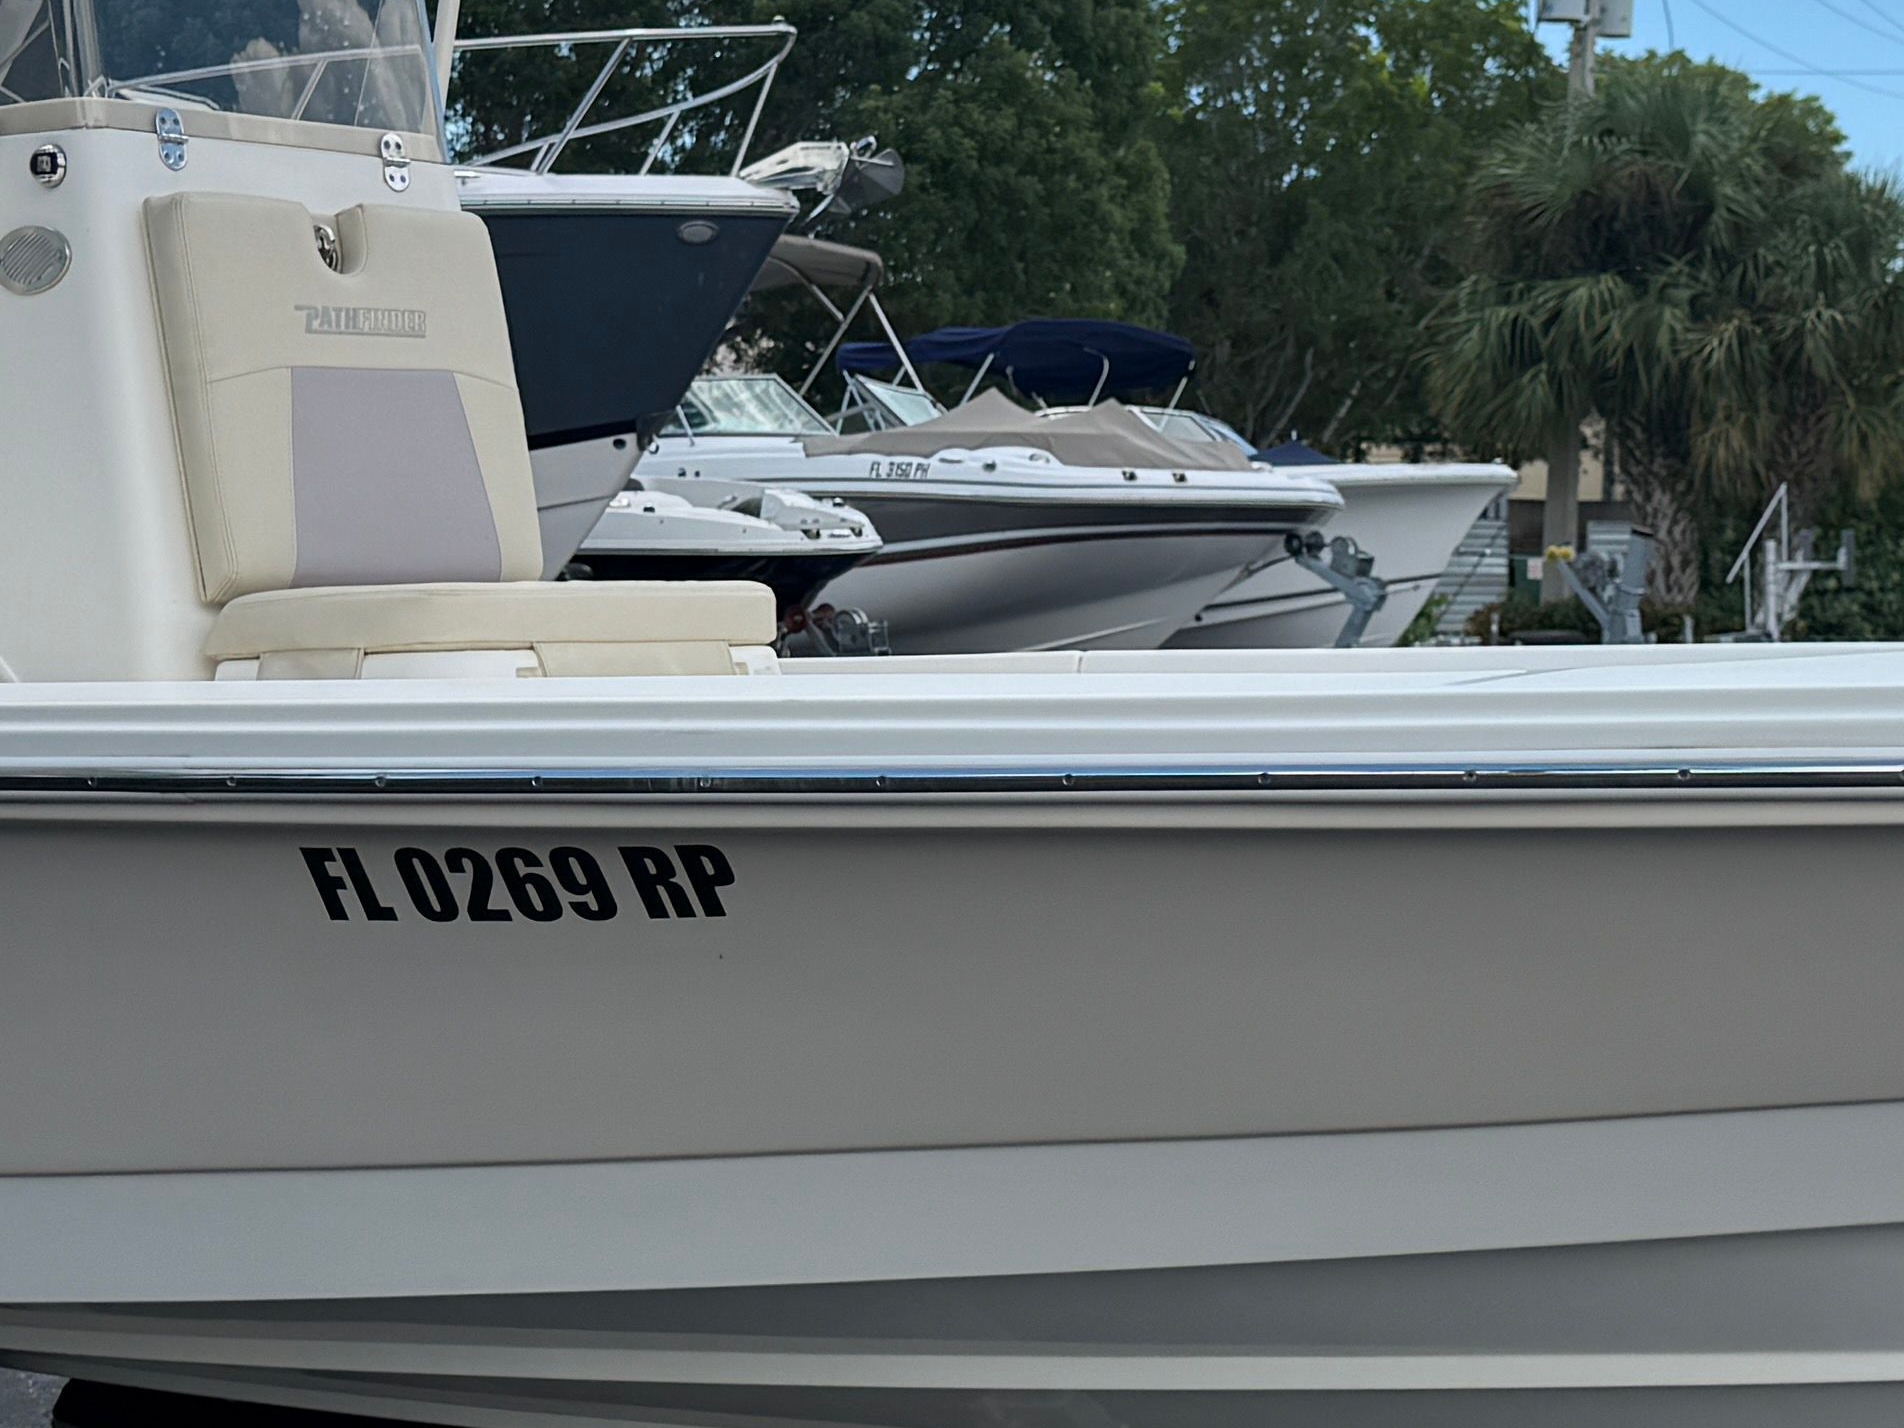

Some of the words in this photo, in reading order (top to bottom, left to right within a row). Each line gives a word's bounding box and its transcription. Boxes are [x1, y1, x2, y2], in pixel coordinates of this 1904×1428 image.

[294, 304, 426, 338] PATHFINDER
[299, 846, 399, 922] FL
[393, 845, 618, 923] 0269
[617, 843, 736, 920] RP
